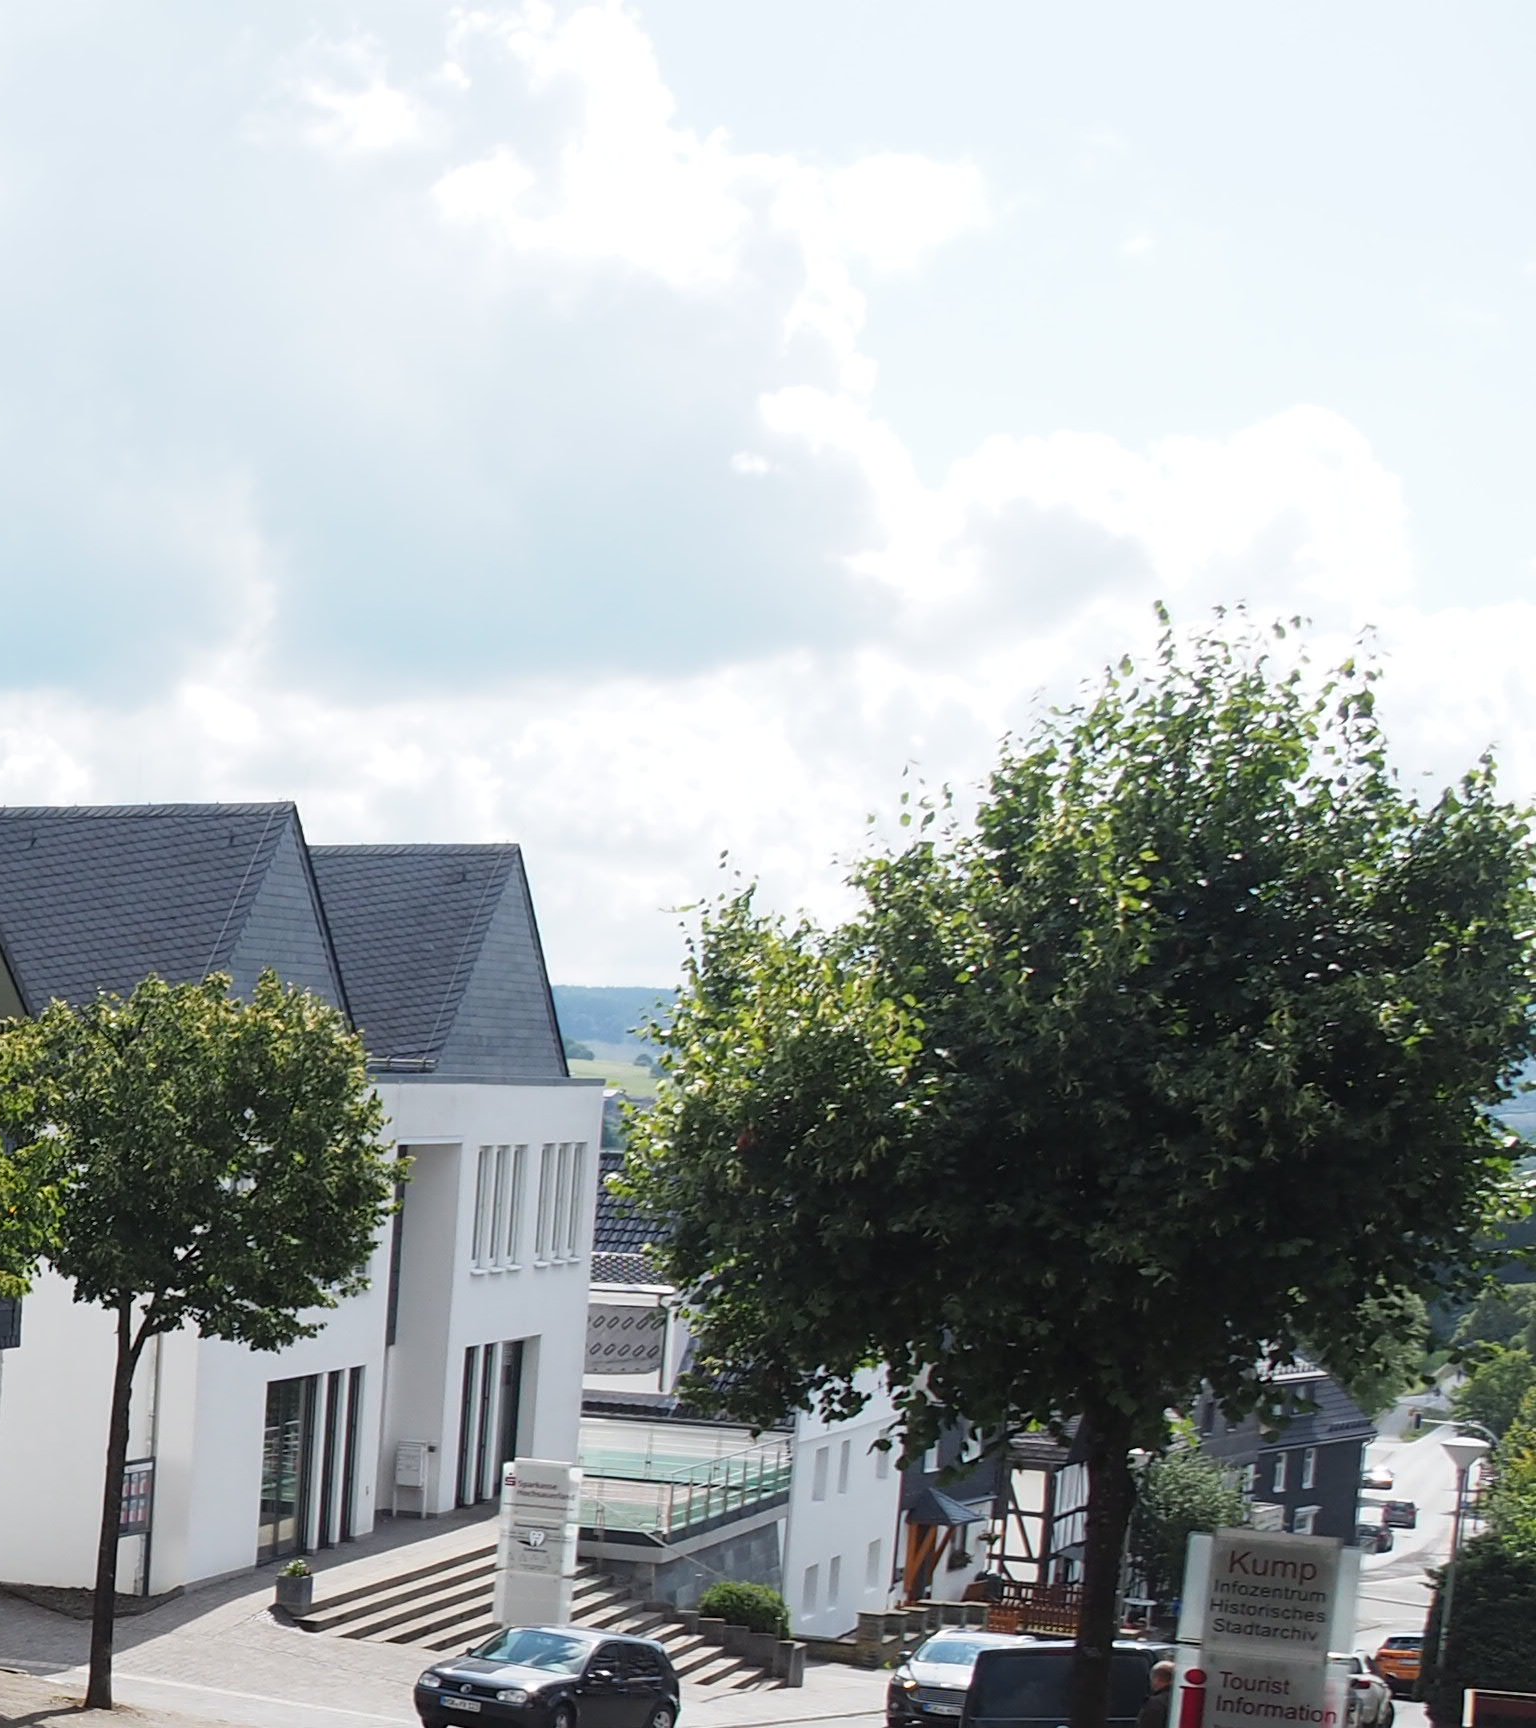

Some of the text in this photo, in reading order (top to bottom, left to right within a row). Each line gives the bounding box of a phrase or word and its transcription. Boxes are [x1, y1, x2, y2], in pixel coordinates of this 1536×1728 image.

[1229, 1550, 1317, 1585] Kump
[1214, 1580, 1326, 1602] Infozentrum
[1210, 1598, 1326, 1623] Historisches
[1213, 1618, 1319, 1641] Stadtarchiv
[1219, 1671, 1290, 1695] Tourist
[1216, 1695, 1336, 1723] Information
